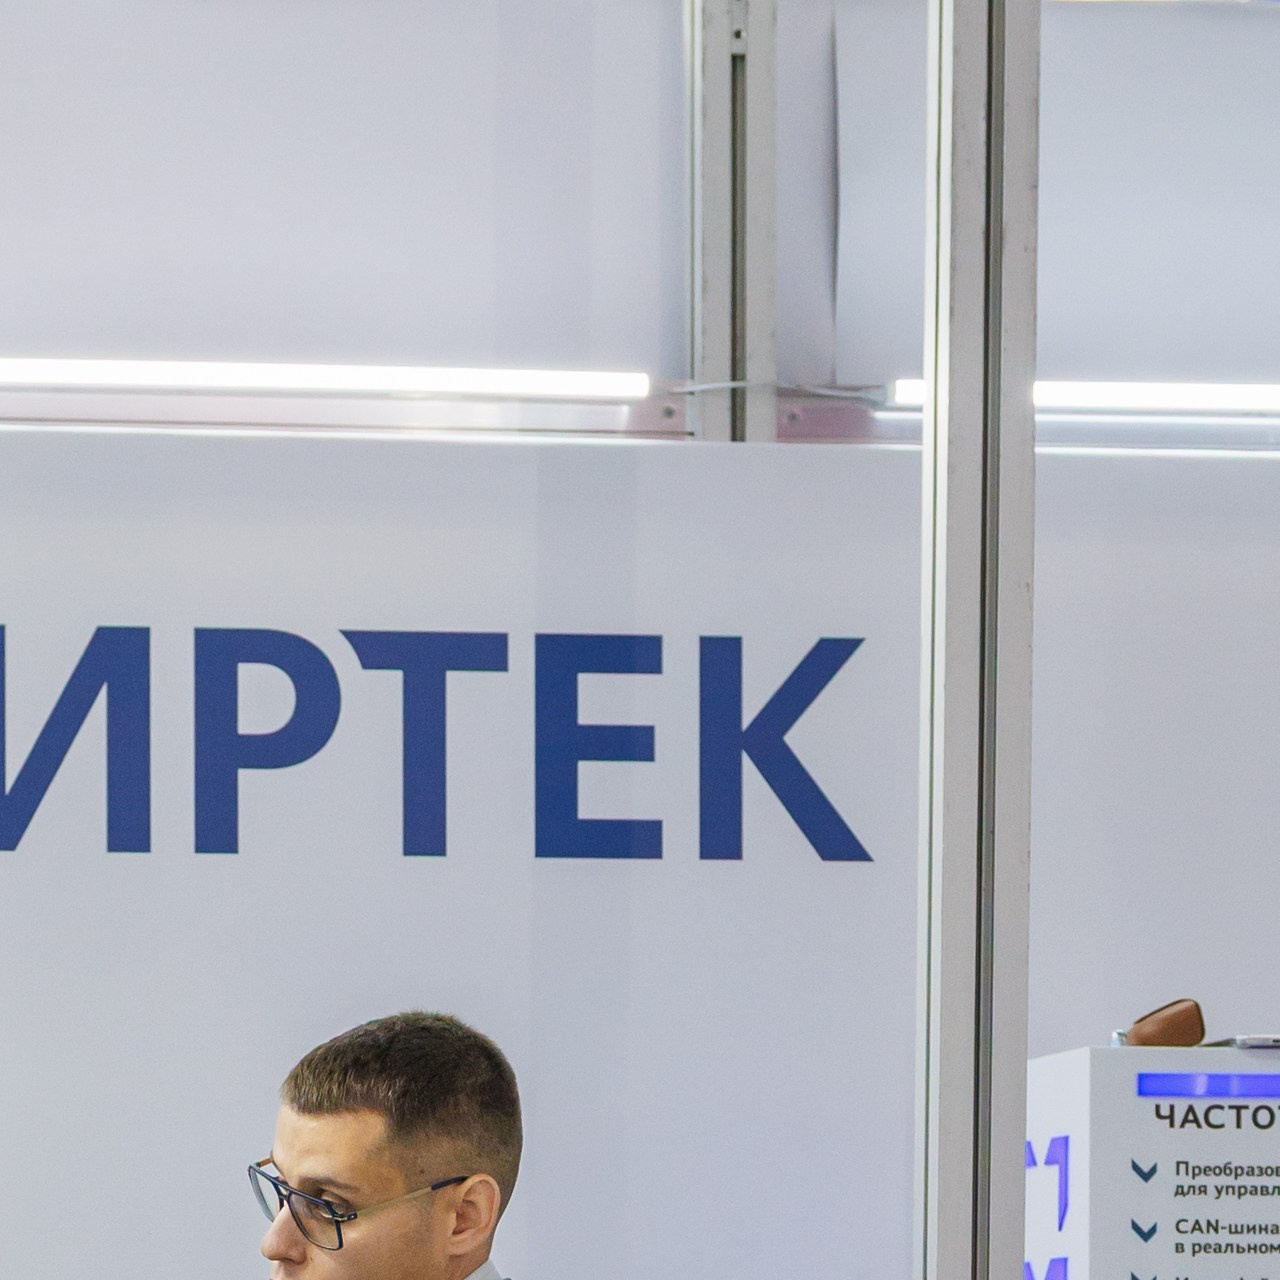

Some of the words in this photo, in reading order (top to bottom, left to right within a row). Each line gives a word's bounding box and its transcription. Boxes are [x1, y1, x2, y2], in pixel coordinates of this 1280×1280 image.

[1154, 1103, 1280, 1130] ЧАСТО
[1174, 1184, 1208, 1198] для
[1214, 1184, 1280, 1200] управл
[1175, 1218, 1280, 1235] CAN-шина
[1175, 1242, 1186, 1254] в
[1191, 1242, 1280, 1257] реальном
